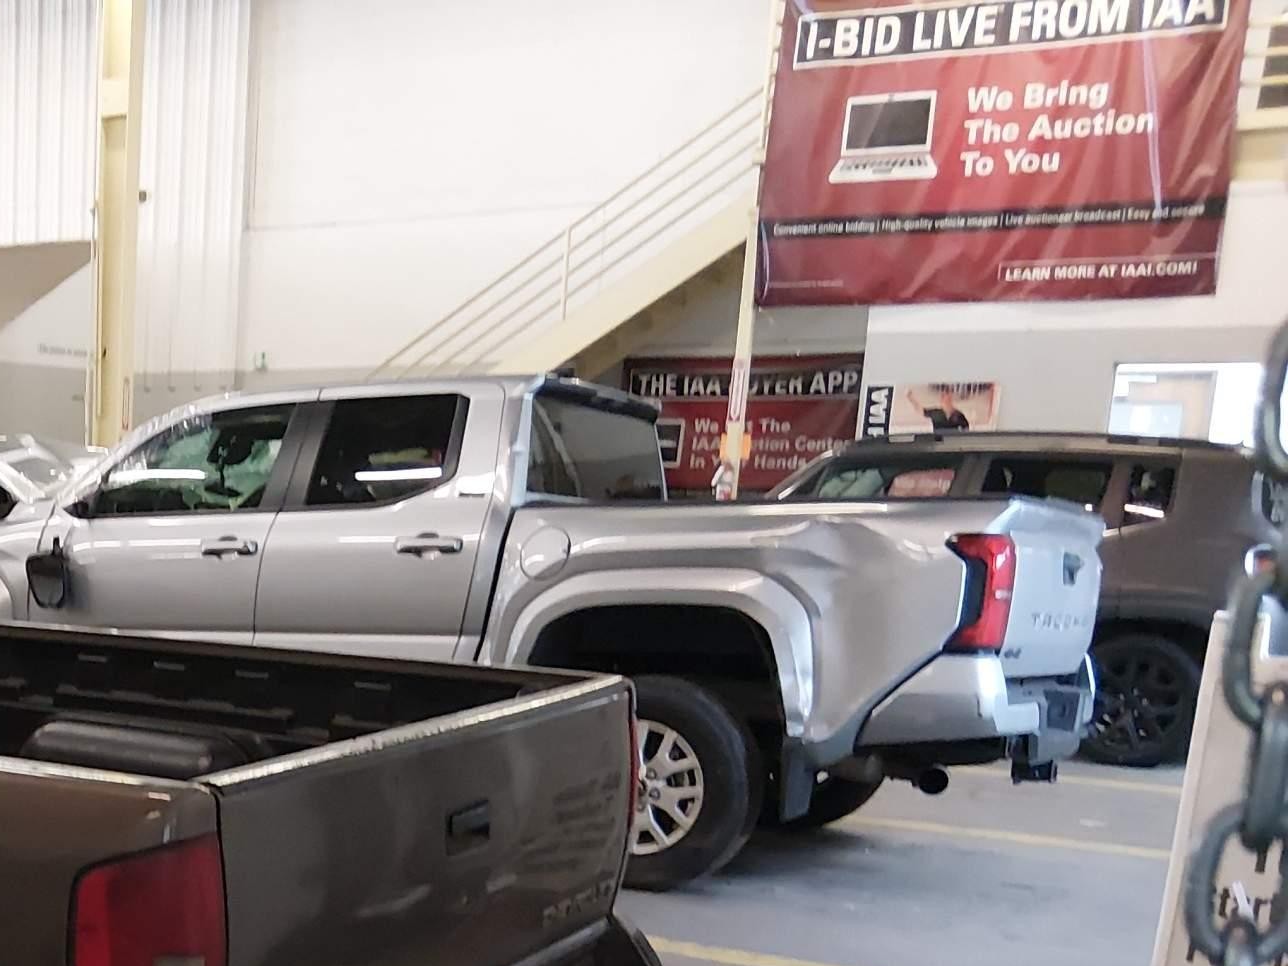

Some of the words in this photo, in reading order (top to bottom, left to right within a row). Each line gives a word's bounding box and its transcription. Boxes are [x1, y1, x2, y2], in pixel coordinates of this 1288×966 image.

[806, 15, 901, 60] I-BID
[913, 4, 999, 51] LIVE
[1009, 0, 1129, 42] FROM
[1142, 0, 1215, 29] IAA
[967, 86, 1014, 113] We
[1024, 80, 1109, 110] Bring
[964, 118, 1020, 145] The
[1027, 109, 1154, 141] Auction
[960, 151, 994, 177] To
[1004, 147, 1060, 175] You
[1005, 265, 1050, 282] LEARN
[1054, 263, 1096, 280] MORE
[1098, 263, 1118, 278] AT
[638, 373, 678, 397] THE
[683, 374, 723, 397] IAA
[810, 370, 859, 395] APP
[694, 417, 719, 434] We
[759, 417, 791, 434] The
[795, 433, 850, 452] Center
[689, 453, 706, 470] In
